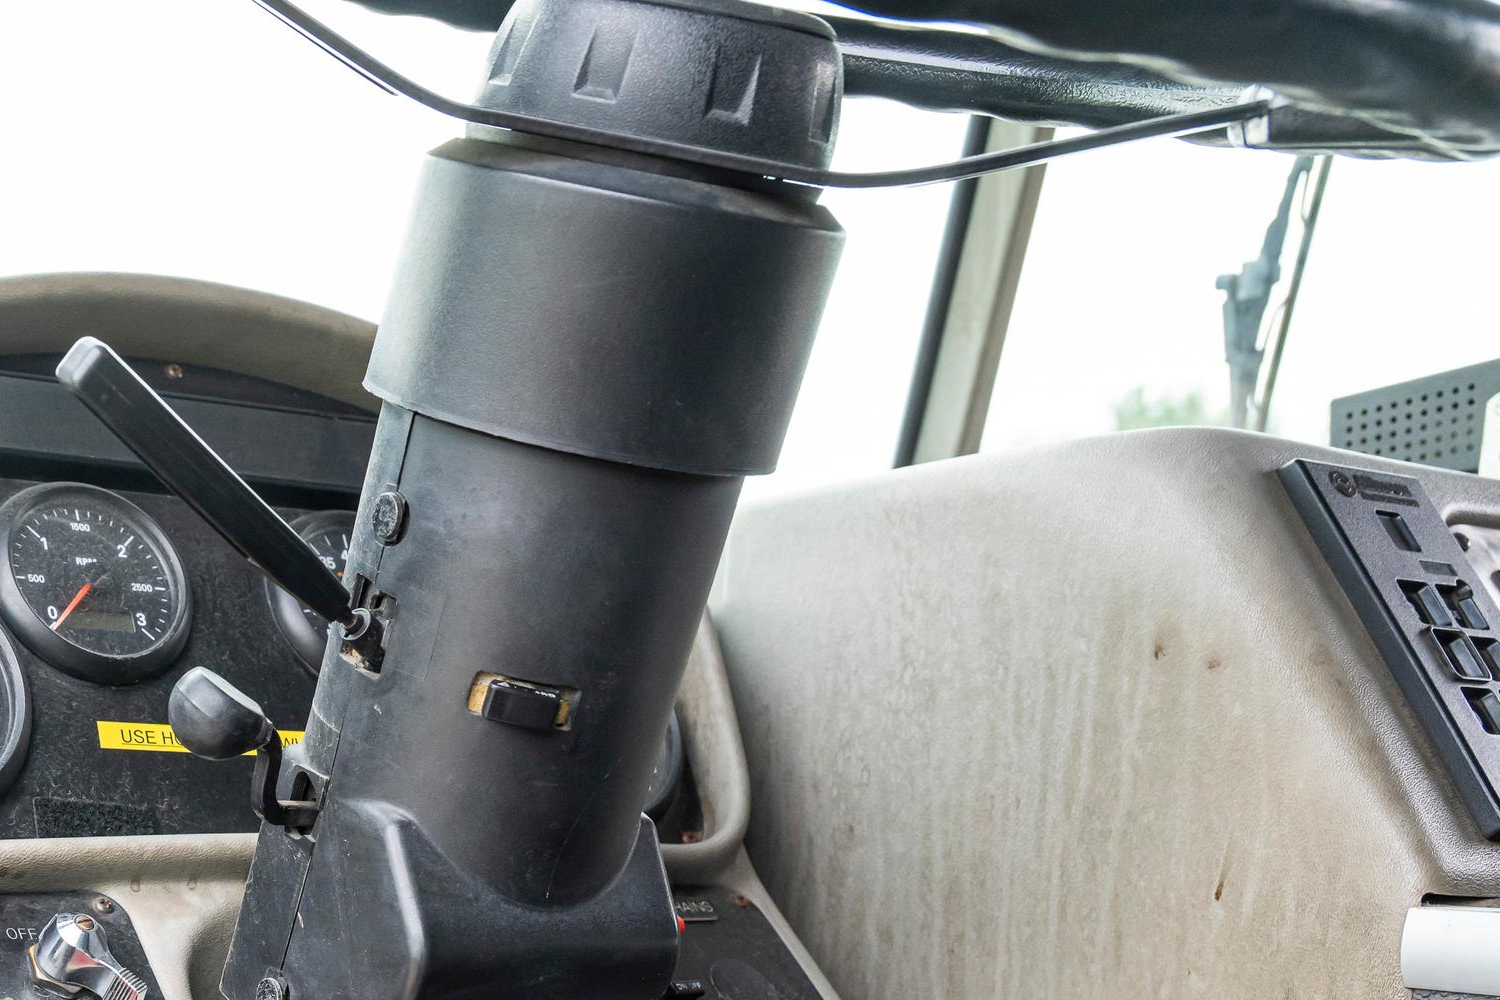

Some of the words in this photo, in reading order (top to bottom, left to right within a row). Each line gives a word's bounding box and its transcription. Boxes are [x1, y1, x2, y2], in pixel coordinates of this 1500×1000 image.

[70, 522, 90, 532] 1500
[40, 537, 48, 550] 1
[117, 545, 128, 558] 2
[341, 549, 348, 560] 4
[28, 574, 45, 583] 500
[131, 583, 153, 592] 2500
[47, 606, 58, 619] 0
[136, 612, 147, 626] 3
[120, 729, 157, 744] USE
[675, 901, 714, 912] HAINS
[6, 928, 37, 940] OFF
